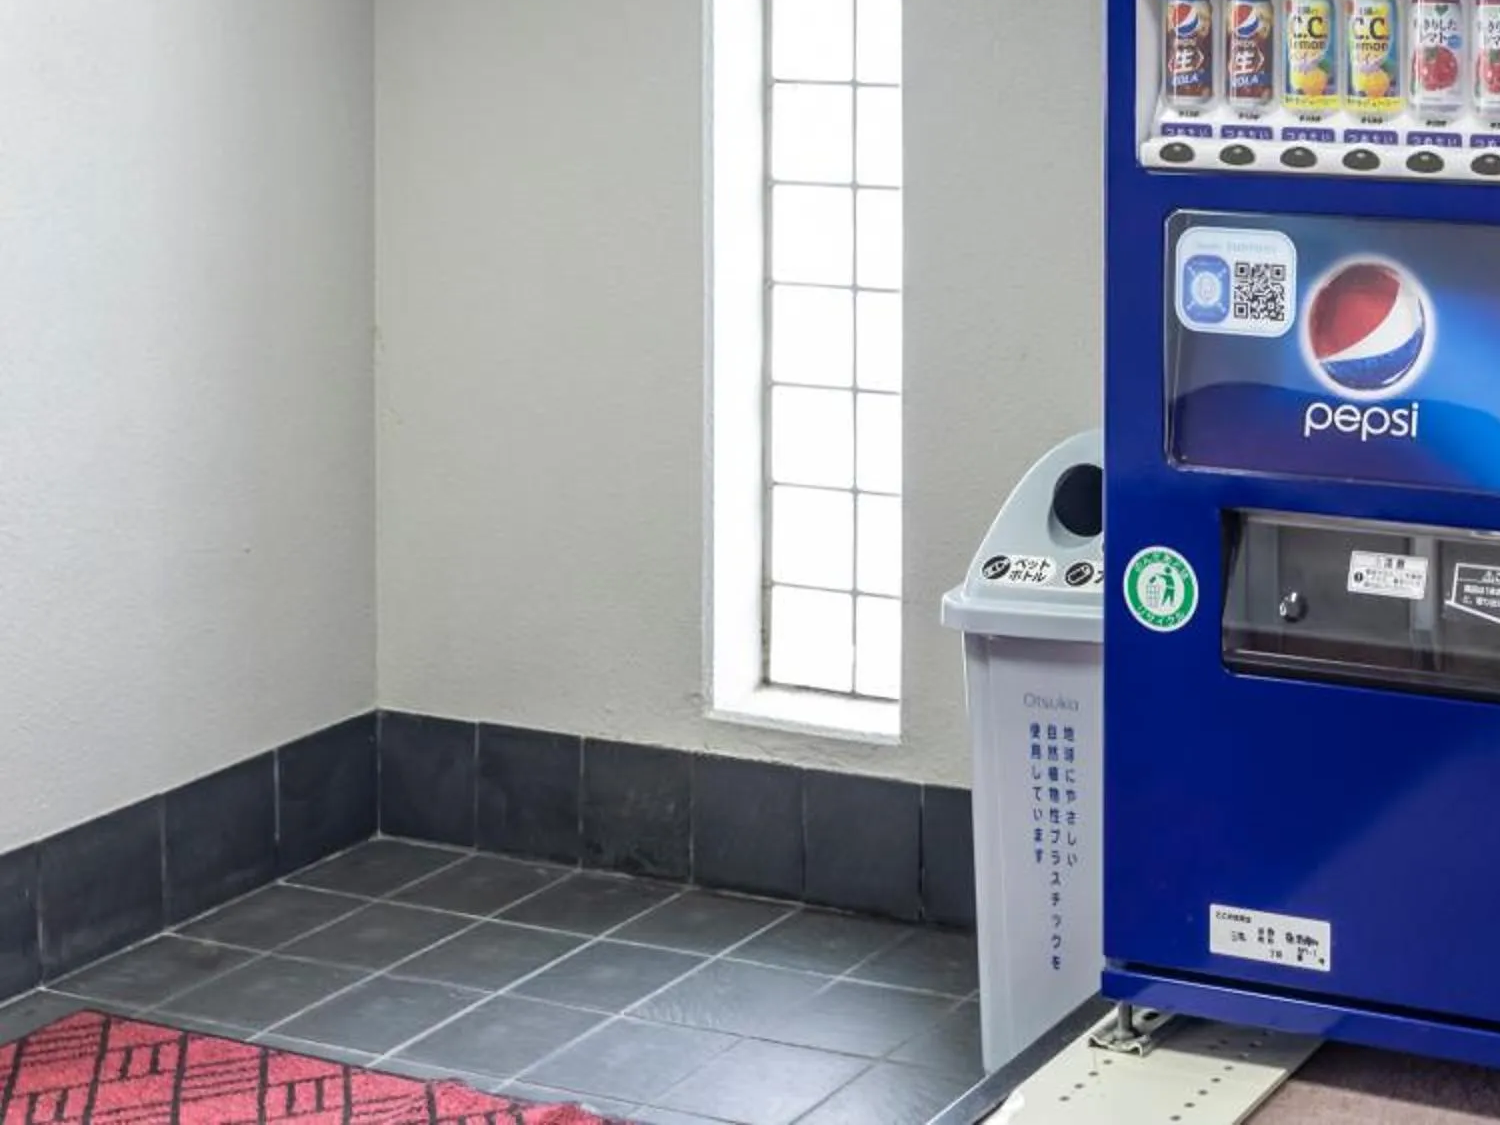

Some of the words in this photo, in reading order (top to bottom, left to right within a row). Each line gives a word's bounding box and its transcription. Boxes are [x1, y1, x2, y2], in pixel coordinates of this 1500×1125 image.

[1304, 402, 1419, 442] pepsi
[1009, 570, 1047, 583] ボトル
[1023, 692, 1080, 713] Otsuka
[1029, 722, 1044, 864] 使用しています
[1062, 726, 1079, 868] 地球にやさしい
[1047, 723, 1063, 972] 自然植物性プラスチックを
